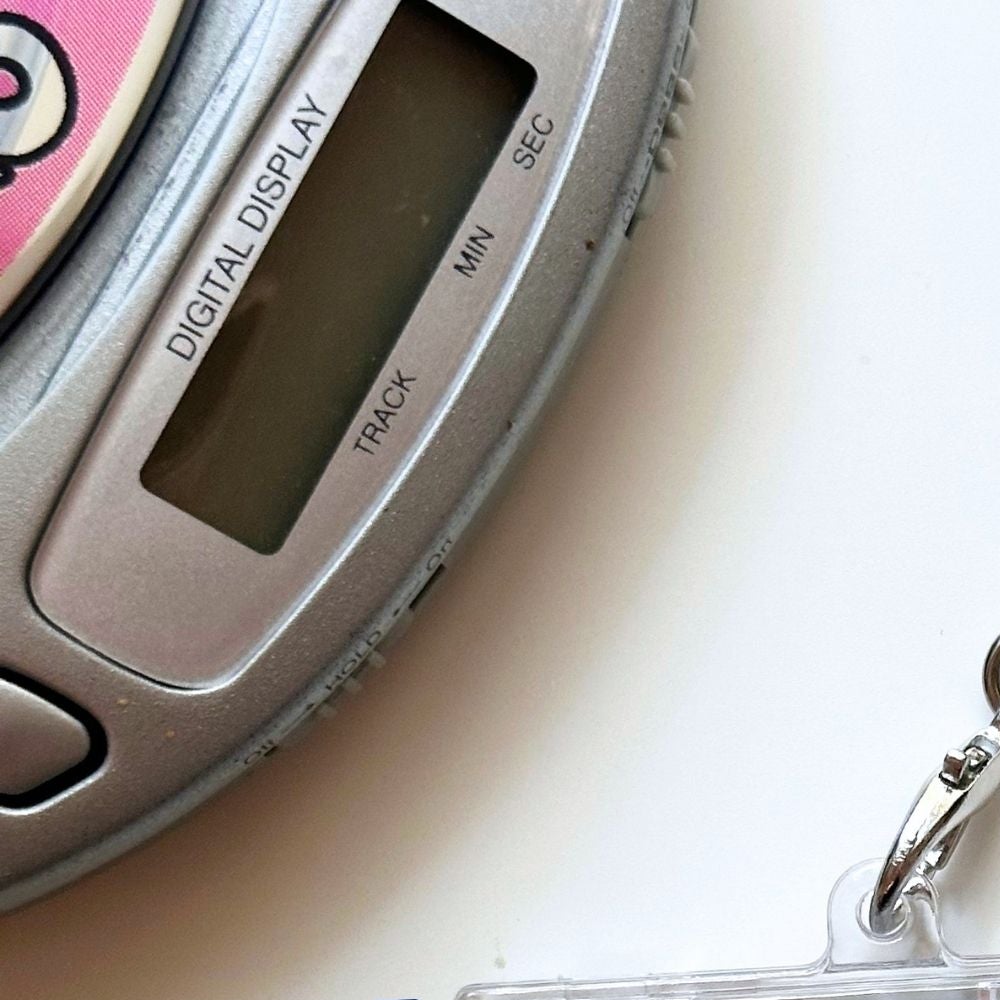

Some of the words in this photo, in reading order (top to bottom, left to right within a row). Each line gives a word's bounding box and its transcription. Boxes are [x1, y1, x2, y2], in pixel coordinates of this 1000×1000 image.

[513, 112, 556, 171] SEC
[166, 241, 254, 363] DIGITAL
[237, 94, 329, 234] DISPLAY
[453, 224, 496, 280] MIN
[352, 370, 417, 459] TRACK
